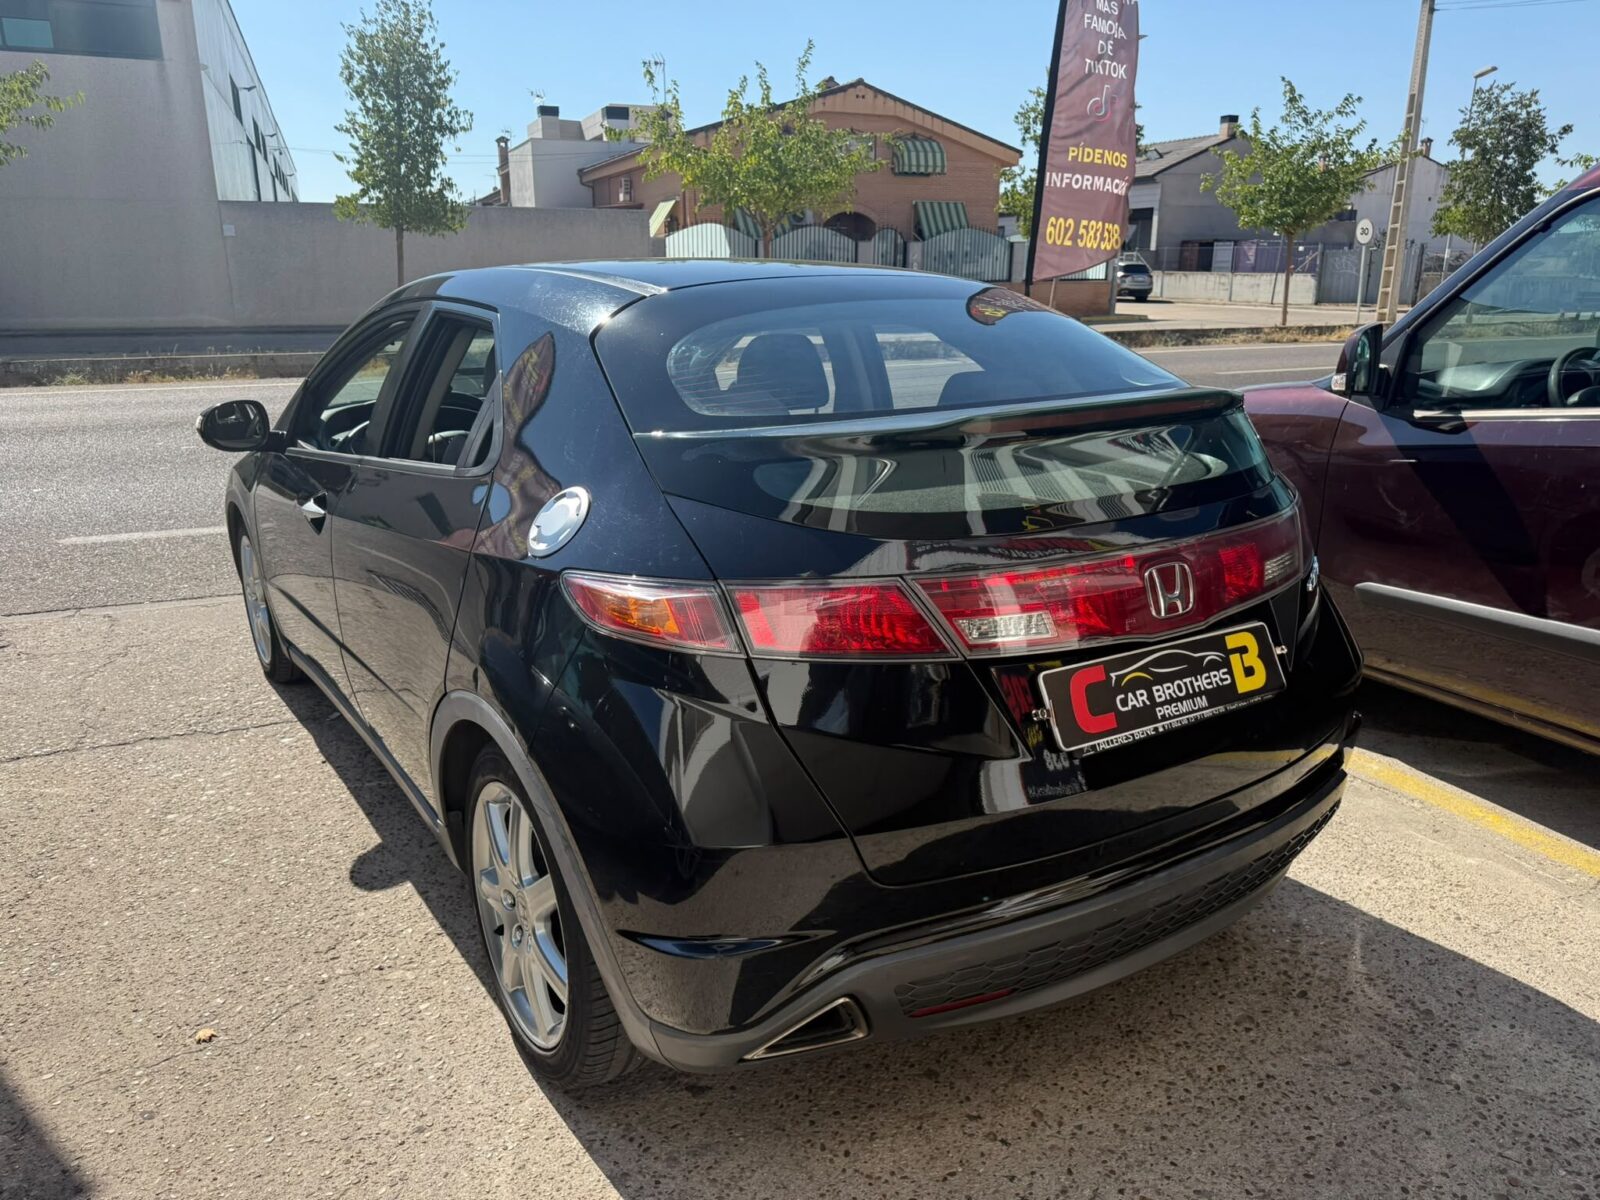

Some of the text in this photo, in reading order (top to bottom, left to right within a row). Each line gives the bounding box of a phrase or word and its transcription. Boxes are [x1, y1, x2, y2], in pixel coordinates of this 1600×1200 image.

[1097, 40, 1114, 56] DE
[1084, 58, 1127, 79] TIKTOK
[1068, 142, 1128, 169] PÍDENOS
[1046, 216, 1075, 246] 602
[1360, 227, 1369, 236] 30
[1116, 689, 1150, 712] CAR
[1152, 668, 1232, 703] BROTHERS
[1155, 695, 1208, 720] PREMIUM
